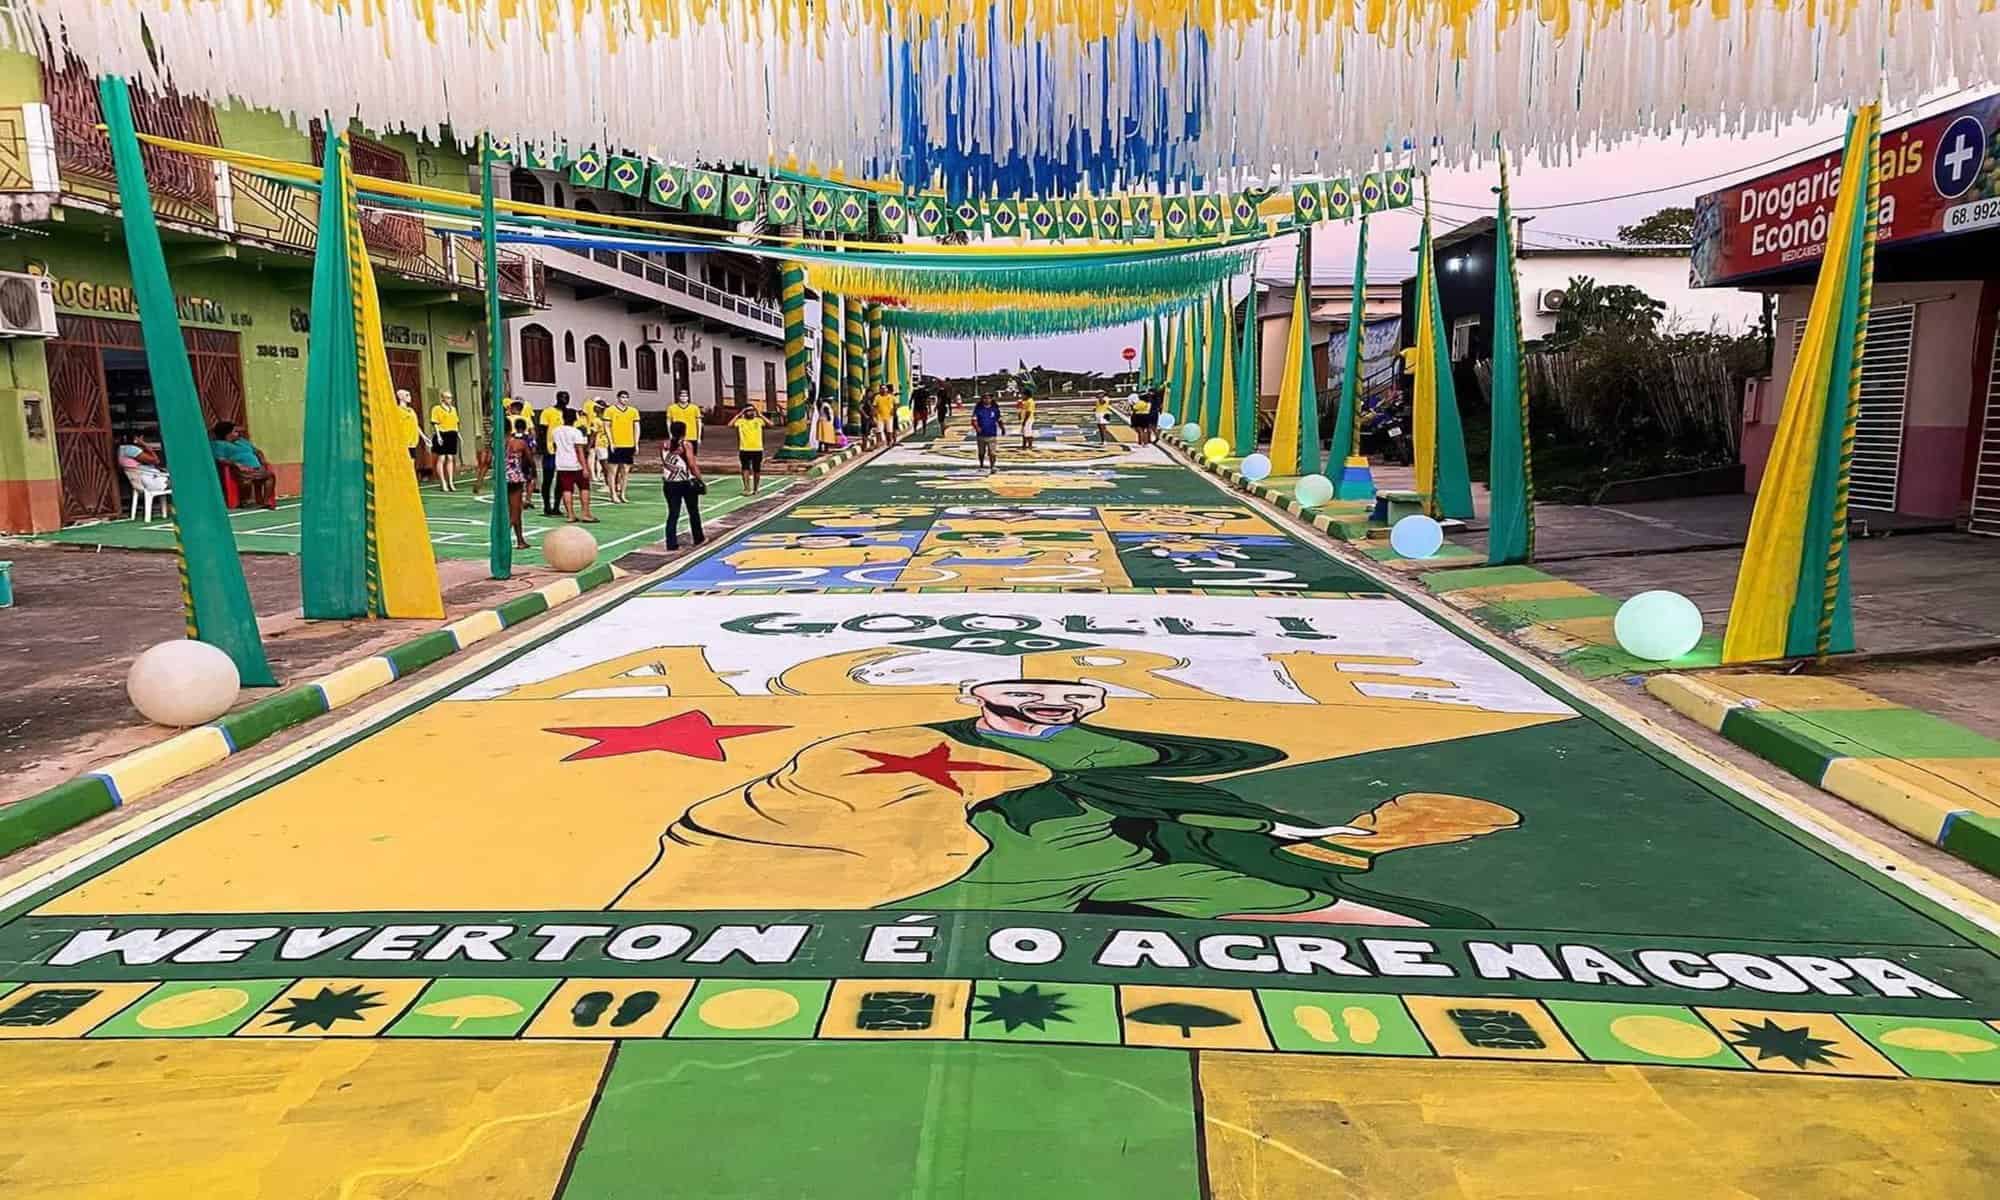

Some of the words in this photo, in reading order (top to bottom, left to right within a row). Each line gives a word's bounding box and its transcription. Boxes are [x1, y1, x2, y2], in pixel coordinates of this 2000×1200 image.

[1740, 159, 1841, 223] Drogaria
[1878, 132, 1923, 182] ais
[1751, 194, 1895, 256] Econôa
[177, 296, 225, 325] NTRO
[951, 637, 1064, 649] DO
[488, 644, 1470, 707] ACRE
[47, 924, 806, 966] WEVERTON
[863, 914, 936, 963] É
[988, 927, 1060, 964] O
[1097, 929, 1455, 977] ACRE
